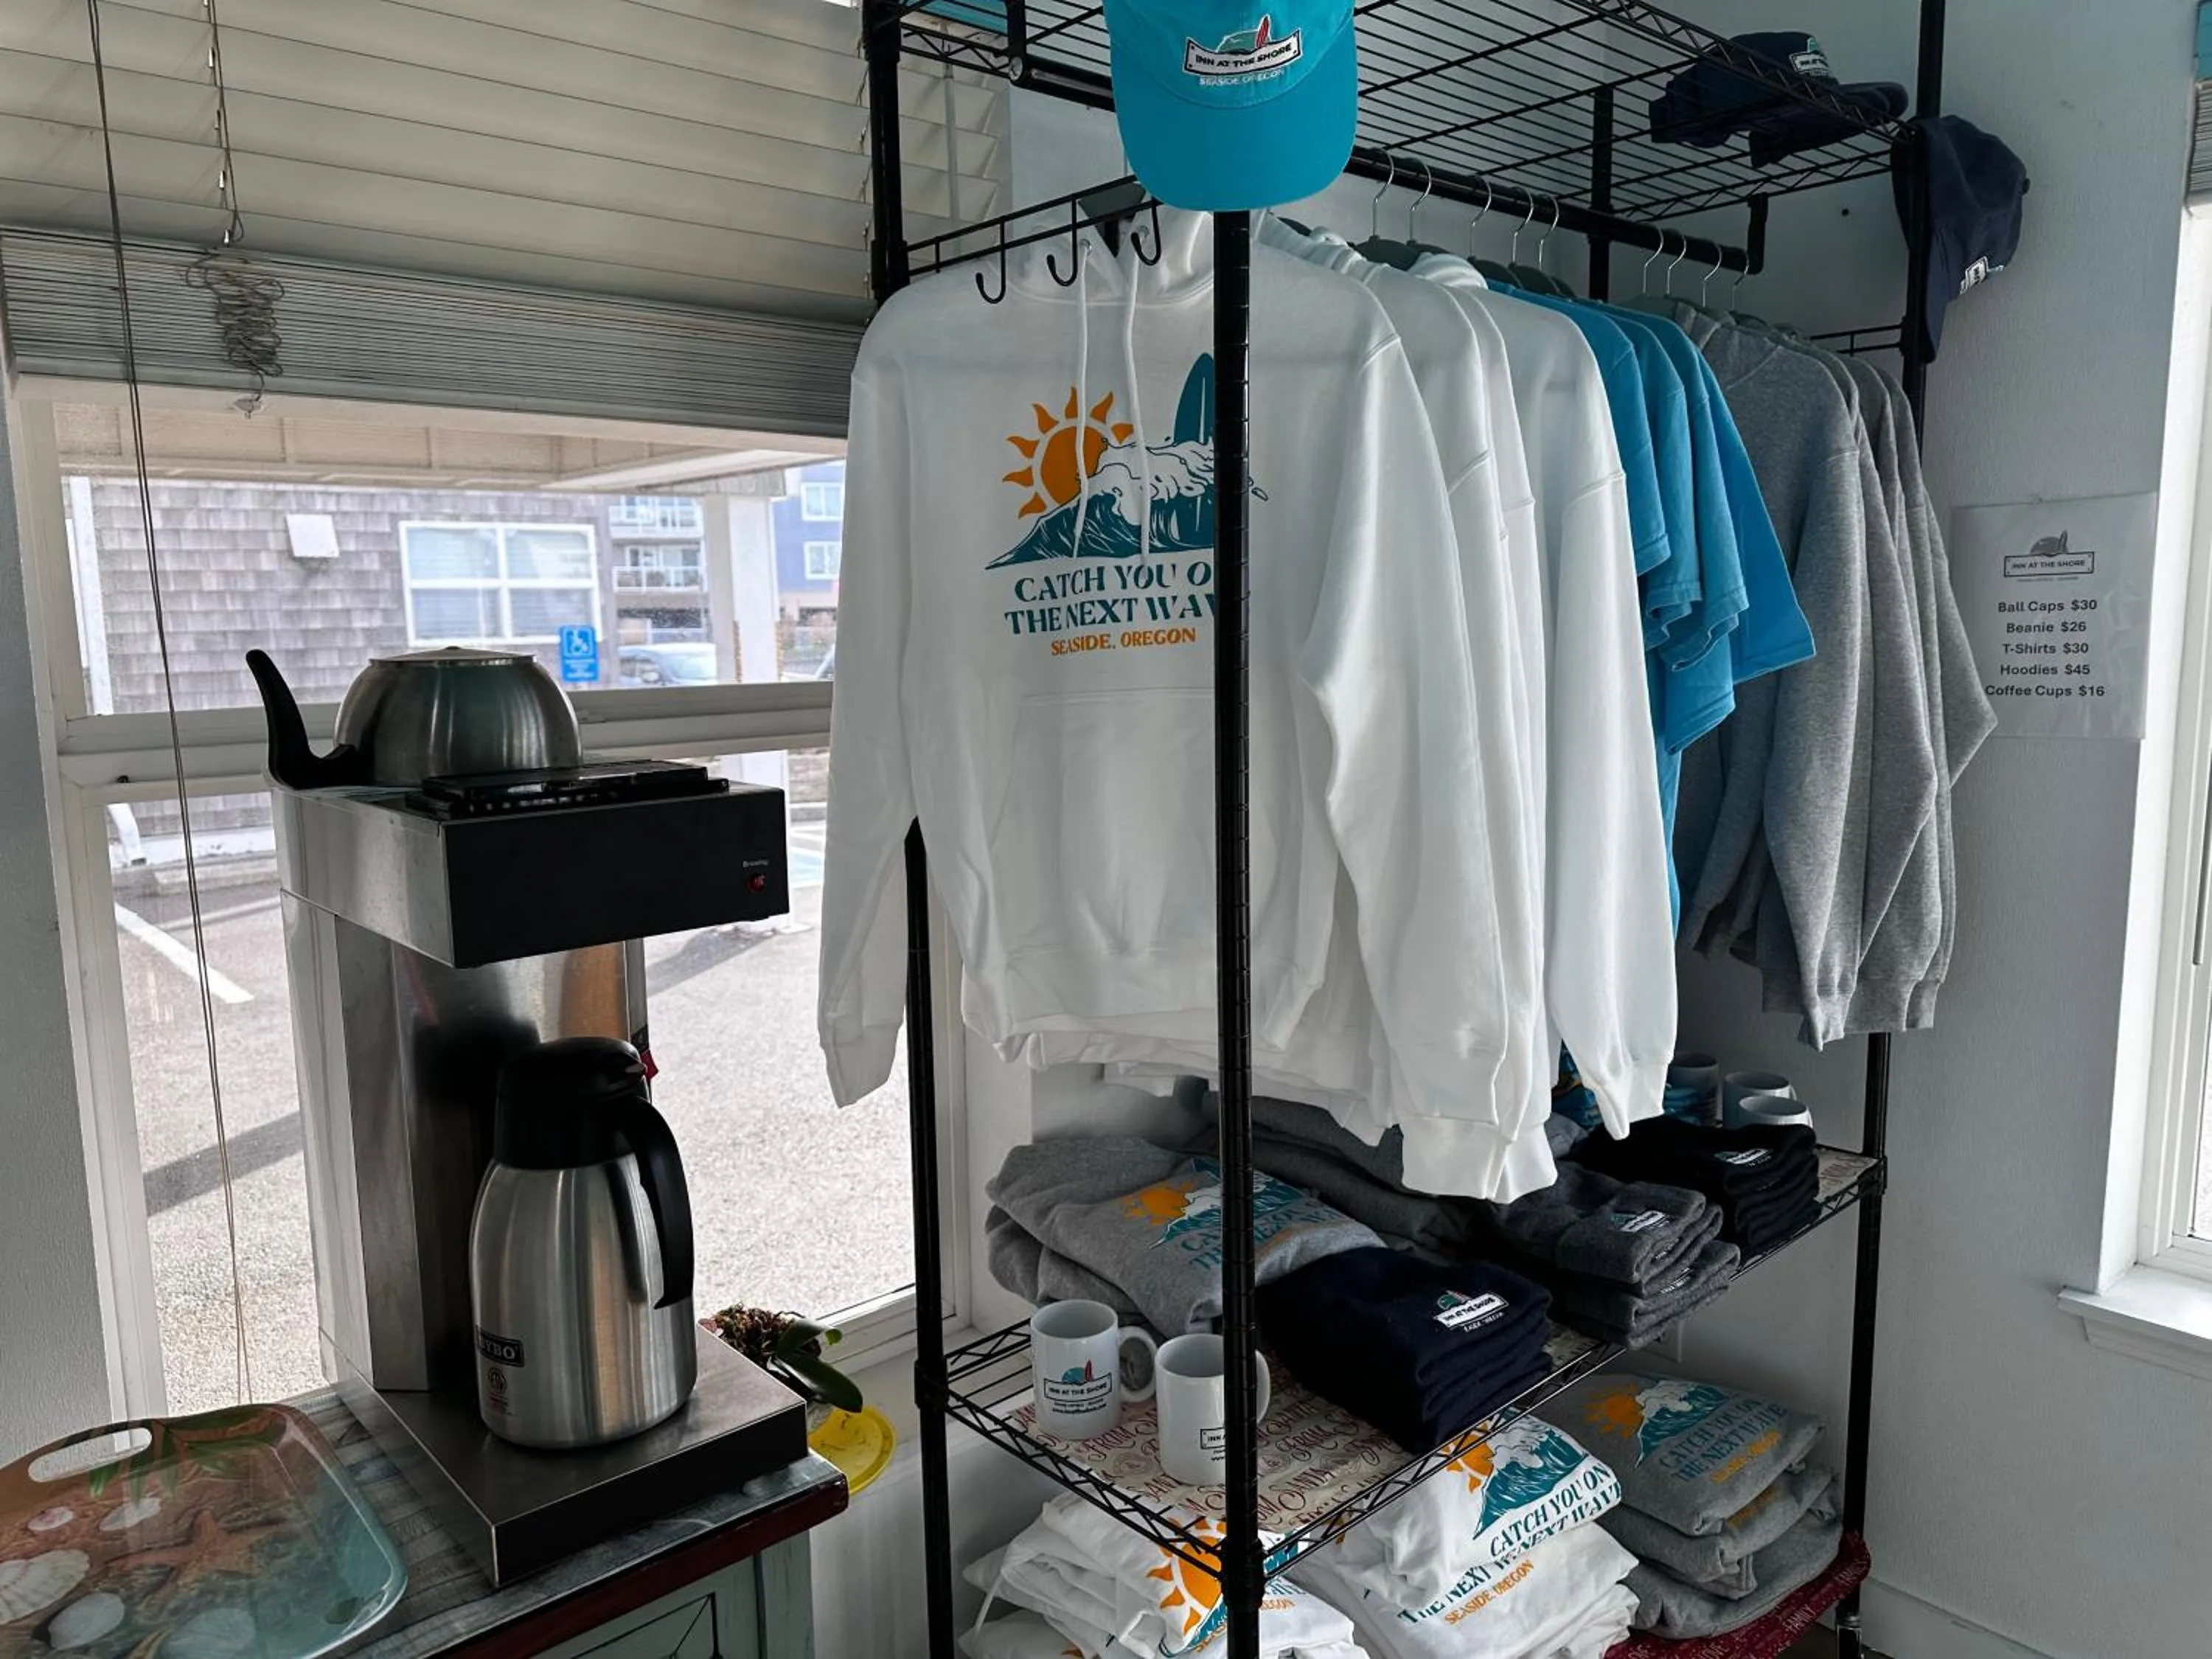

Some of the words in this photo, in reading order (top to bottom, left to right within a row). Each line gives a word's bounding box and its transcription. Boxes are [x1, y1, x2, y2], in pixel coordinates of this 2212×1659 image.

[1217, 58, 1230, 67] AT
[1232, 58, 1255, 67] THE
[1256, 42, 1293, 62] SHORE
[1014, 566, 1106, 602] CATCH
[1113, 562, 1177, 590] YOU
[1186, 560, 1213, 587] O
[1004, 606, 1062, 636] THE
[1066, 597, 1138, 630] NEXT
[1145, 593, 1217, 621] WAV
[1997, 602, 2024, 613] Ball
[2028, 601, 2065, 613] Caps
[2070, 599, 2098, 611] $30
[1120, 627, 1196, 647] OREGON
[2006, 622, 2054, 633] Beanie
[2003, 643, 2056, 654] T-Shirts
[2062, 642, 2089, 654] $30
[2000, 664, 2058, 675] Hoodies
[2064, 664, 2090, 676] $45
[1984, 685, 2031, 696] Coffee
[2035, 685, 2072, 699] Cups
[2079, 685, 2105, 697] $16
[1700, 1428, 1745, 1460] NEXT
[1489, 1503, 1549, 1557] CATCH
[1549, 1479, 1584, 1515] YOU
[1583, 1464, 1612, 1491] ON
[1444, 1564, 1492, 1604] NEXT
[1492, 1559, 1534, 1596] OREGON
